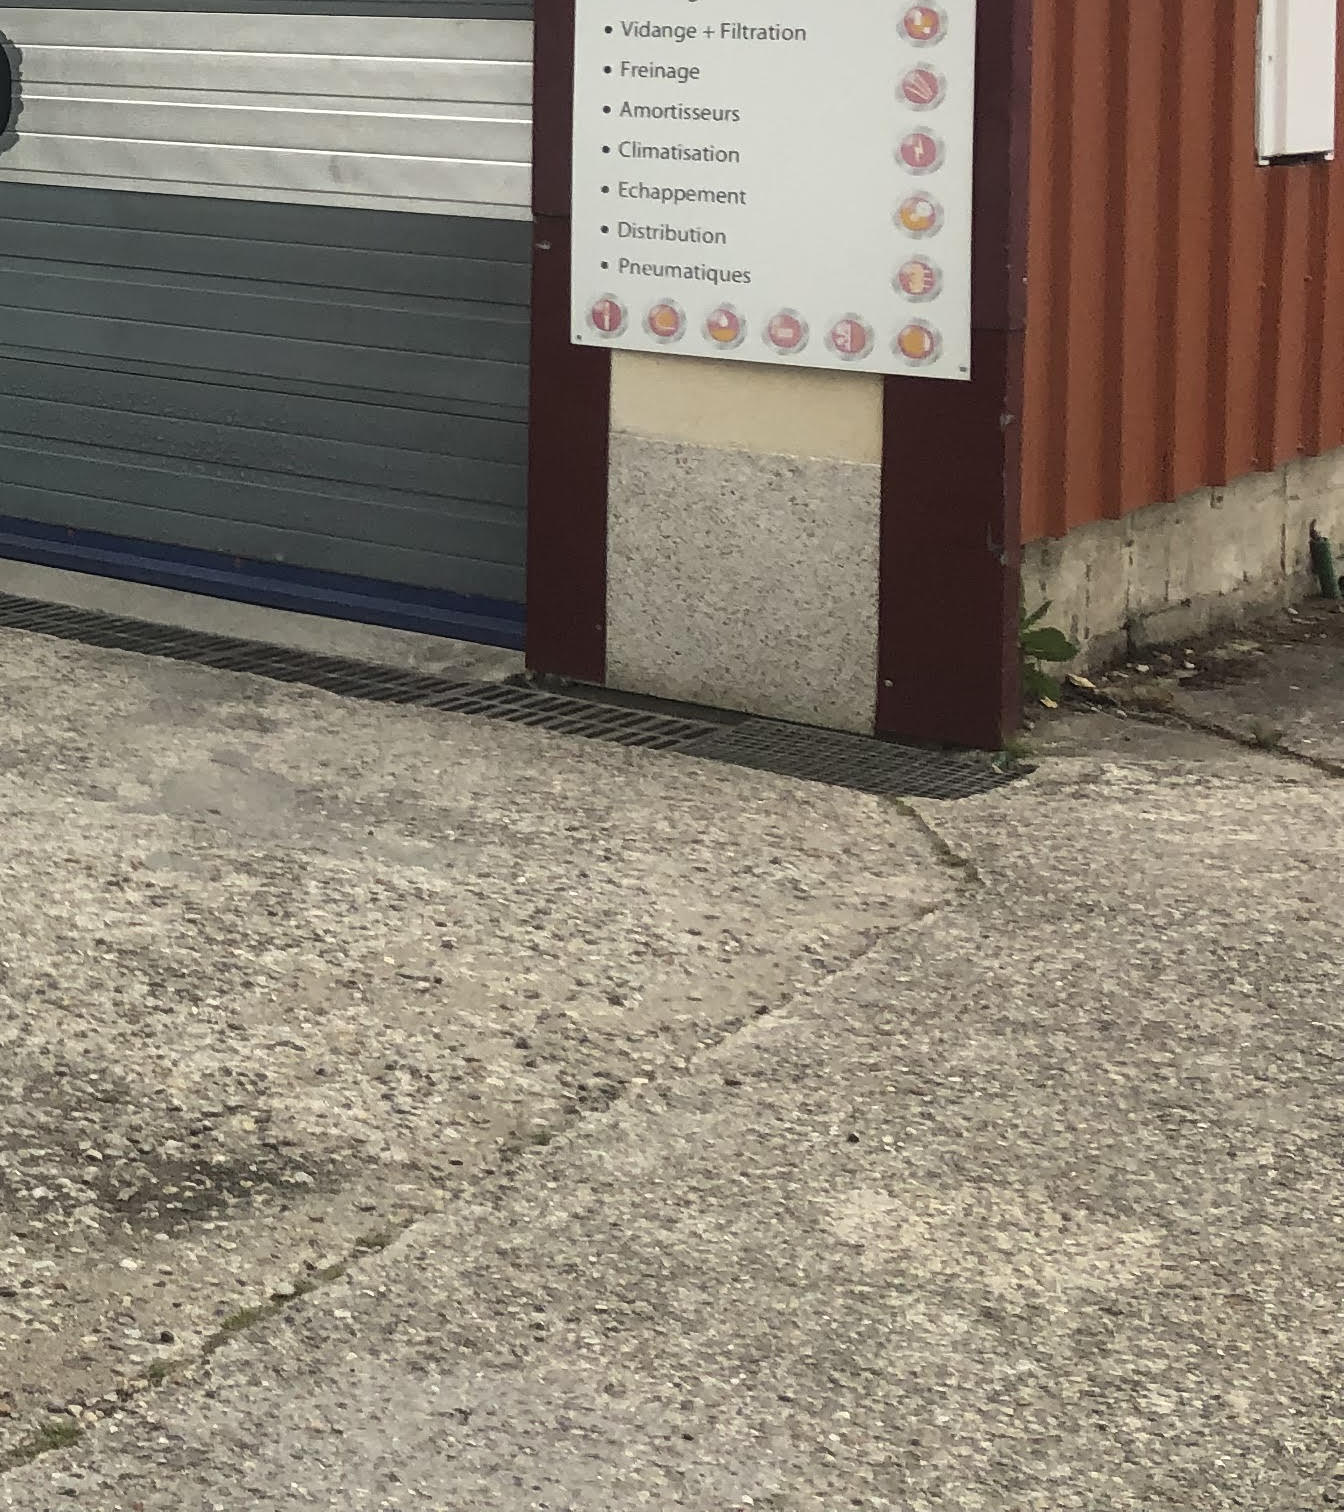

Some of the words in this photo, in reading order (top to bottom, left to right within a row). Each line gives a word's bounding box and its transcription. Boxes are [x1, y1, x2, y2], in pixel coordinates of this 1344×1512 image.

[620, 22, 698, 44] Vidange
[720, 22, 807, 42] Filtration
[620, 60, 700, 82] Freinage
[619, 101, 741, 123] Amortisseurs
[618, 140, 741, 164] Climatisation
[618, 181, 747, 206] Echappement
[617, 221, 727, 246] Distribution
[618, 258, 752, 285] Pneumatiques
